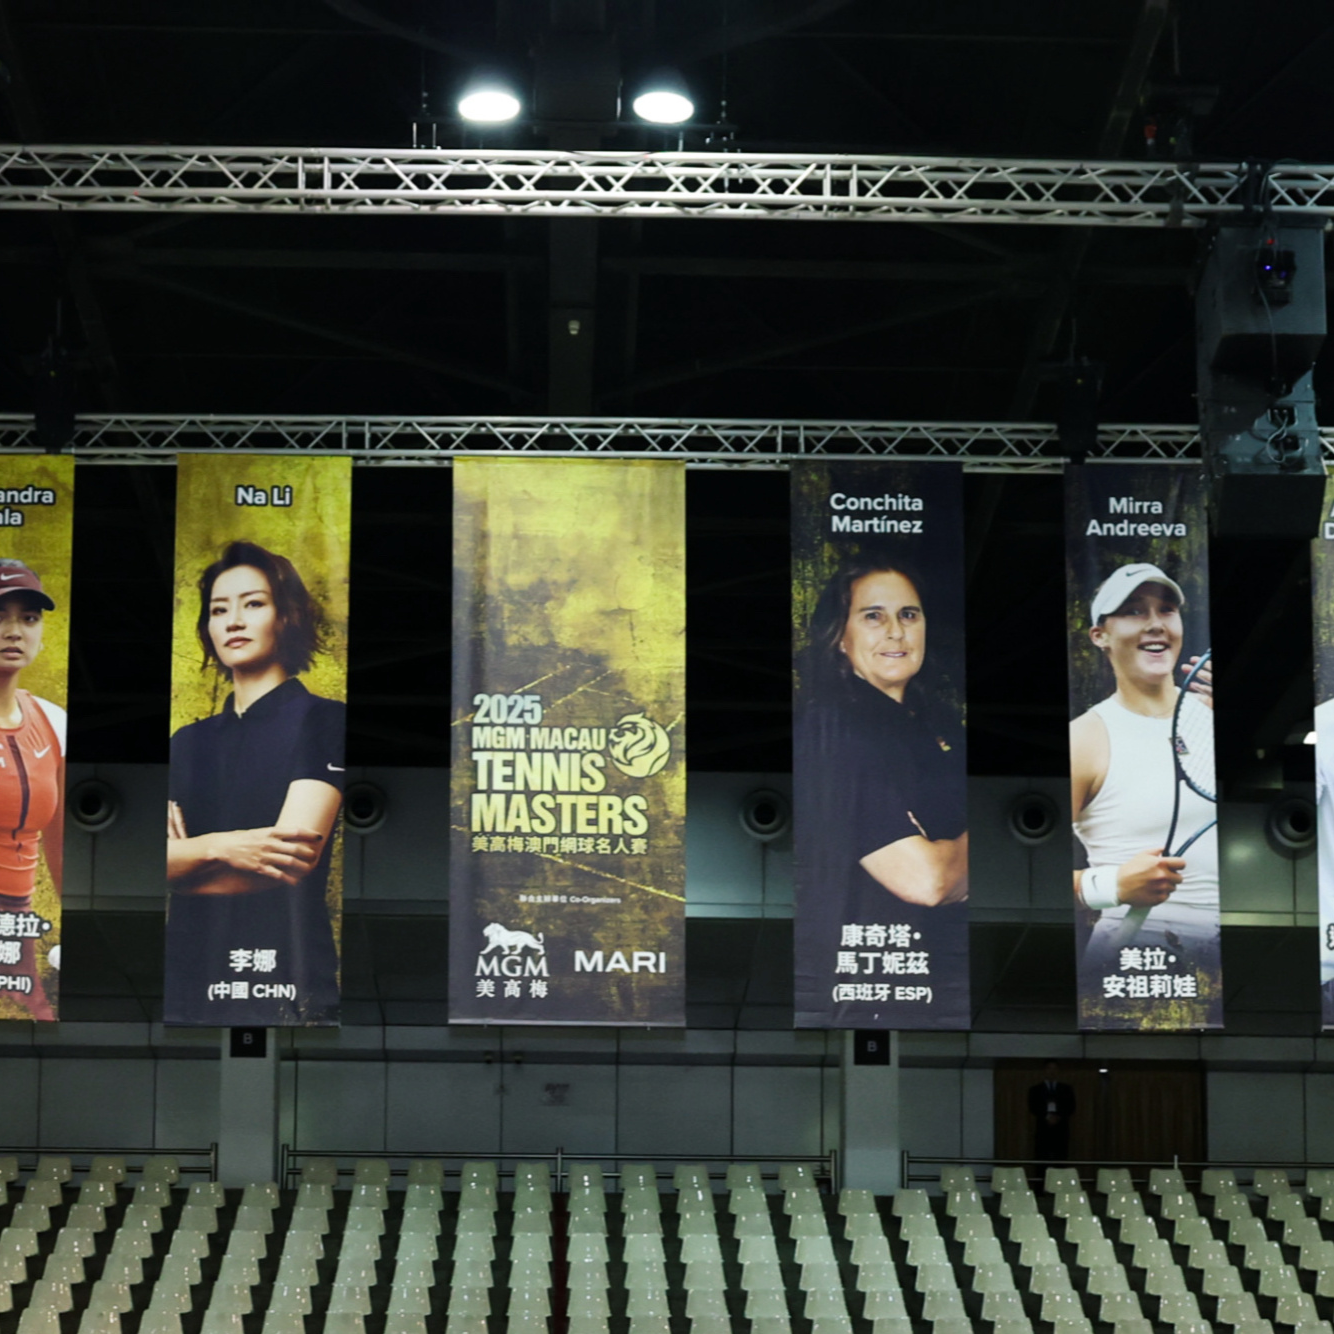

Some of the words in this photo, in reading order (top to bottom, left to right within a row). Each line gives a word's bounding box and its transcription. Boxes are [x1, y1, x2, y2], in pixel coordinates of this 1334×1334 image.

[236, 485, 267, 507] Na
[271, 485, 292, 507] Li
[830, 493, 924, 513] Conchita
[1109, 496, 1162, 515] Mirra
[832, 513, 923, 534] Martínez
[1086, 518, 1186, 537] Andreeva
[473, 694, 542, 725] 2025
[472, 727, 525, 750] MGM
[530, 727, 606, 752] MACAU
[472, 751, 605, 793] TENNIS
[471, 794, 648, 835] MASTERS
[471, 834, 648, 855] 美高梅澳門網球名人賽
[230, 949, 277, 973] 李娜
[475, 955, 550, 977] MGM
[574, 950, 666, 973] MARI
[208, 981, 248, 1001] (中國
[252, 983, 296, 1001] CHN)
[476, 979, 548, 998] 美高梅
[832, 983, 891, 1003] (西班牙
[894, 986, 932, 1004] ESP)
[1103, 973, 1197, 999] 安祖莉娃
[243, 1033, 253, 1044] B
[867, 1041, 877, 1052] B
